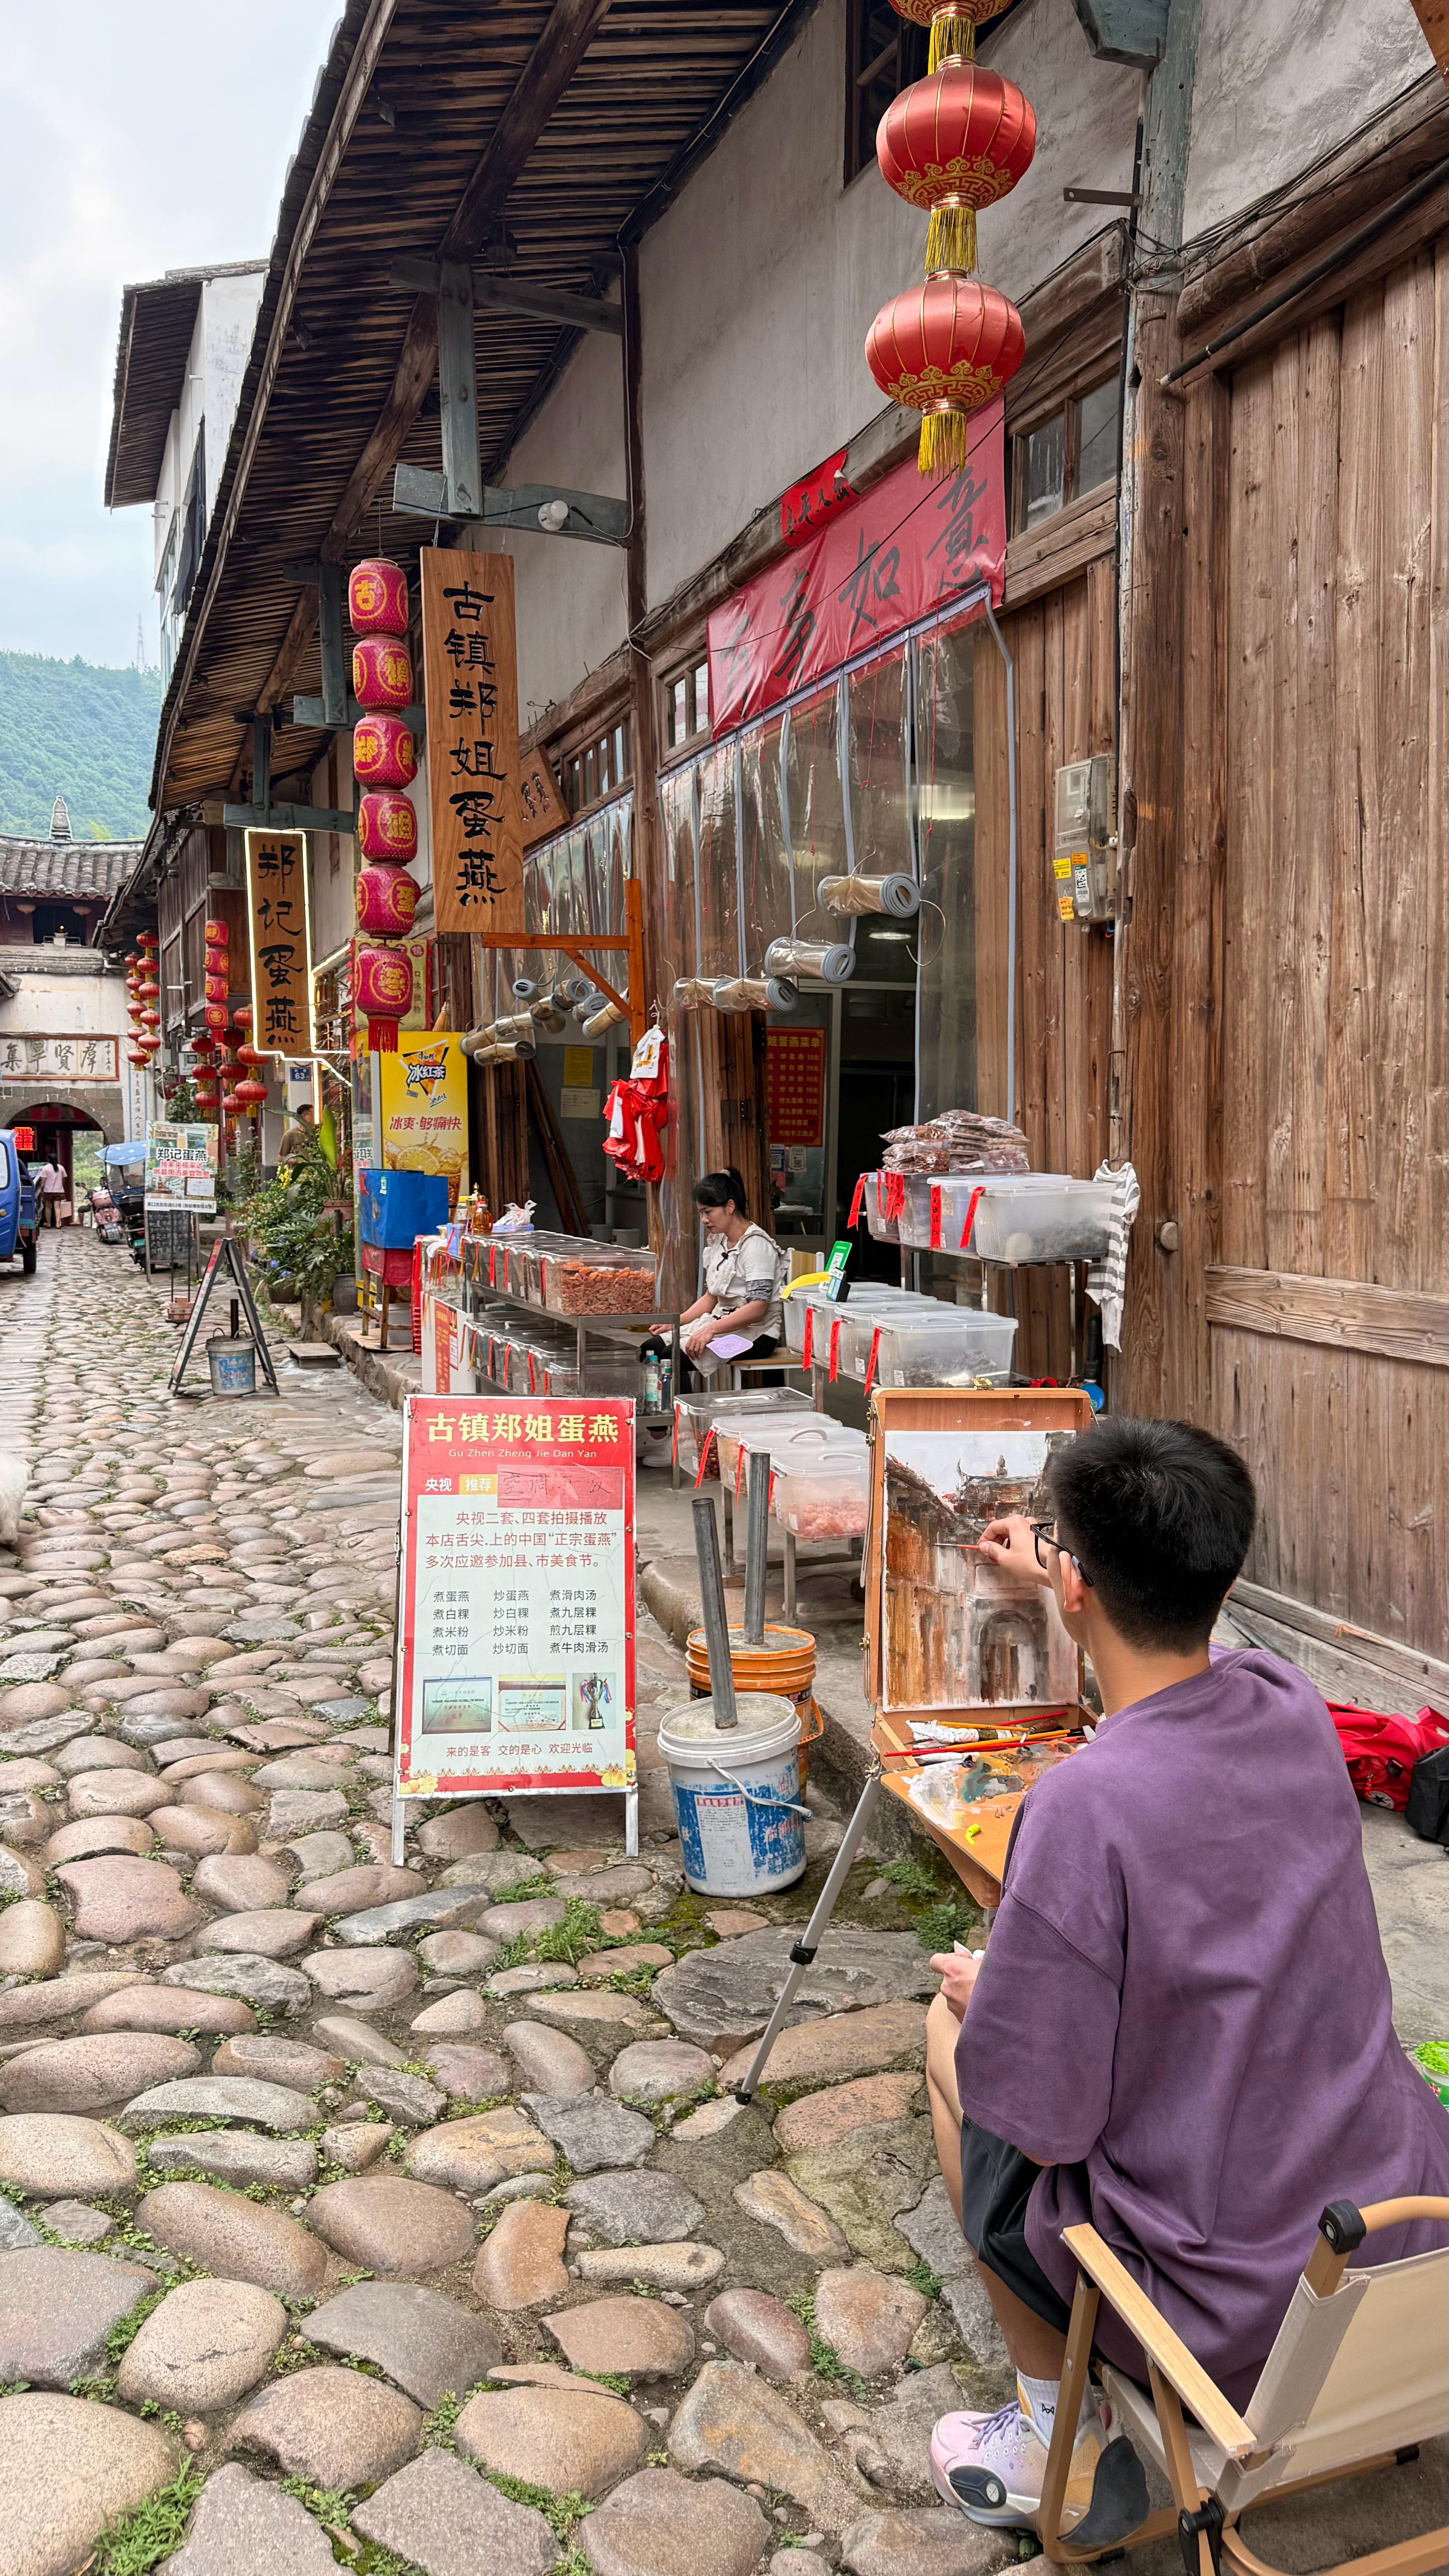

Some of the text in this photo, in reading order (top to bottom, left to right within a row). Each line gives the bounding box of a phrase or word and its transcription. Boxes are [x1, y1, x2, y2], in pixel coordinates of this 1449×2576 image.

[355, 580, 376, 610] 古
[443, 581, 507, 907] 古镇郑姐蛋燕
[258, 844, 304, 1045] 郑记蛋燕
[407, 1065, 445, 1084] 冰红茶
[157, 1148, 207, 1161] 郑记蛋燕
[426, 1412, 619, 1444] 古镇郑姐蛋燕
[448, 1449, 597, 1459] Gu Zhen Zheng Jie Dan Yan
[425, 1477, 492, 1493] 央视 推荐
[456, 1512, 607, 1526] 央视二套、四套拍摄播放
[426, 1555, 599, 1569] 多次应邀参加县、市美食节。
[433, 1589, 597, 1603] 煮蛋燕 炒蛋燕 煮滑肉汤
[433, 1607, 597, 1620] 煮白粿 炒白粿 煮九层粿
[432, 1624, 597, 1638] 煮米粉 炒米粉 煎九层粿
[432, 1642, 608, 1656] 煮切面 炒切面 煮牛肉滑汤
[446, 1743, 593, 1757] 来的是客 交的是心 欢迎光临
